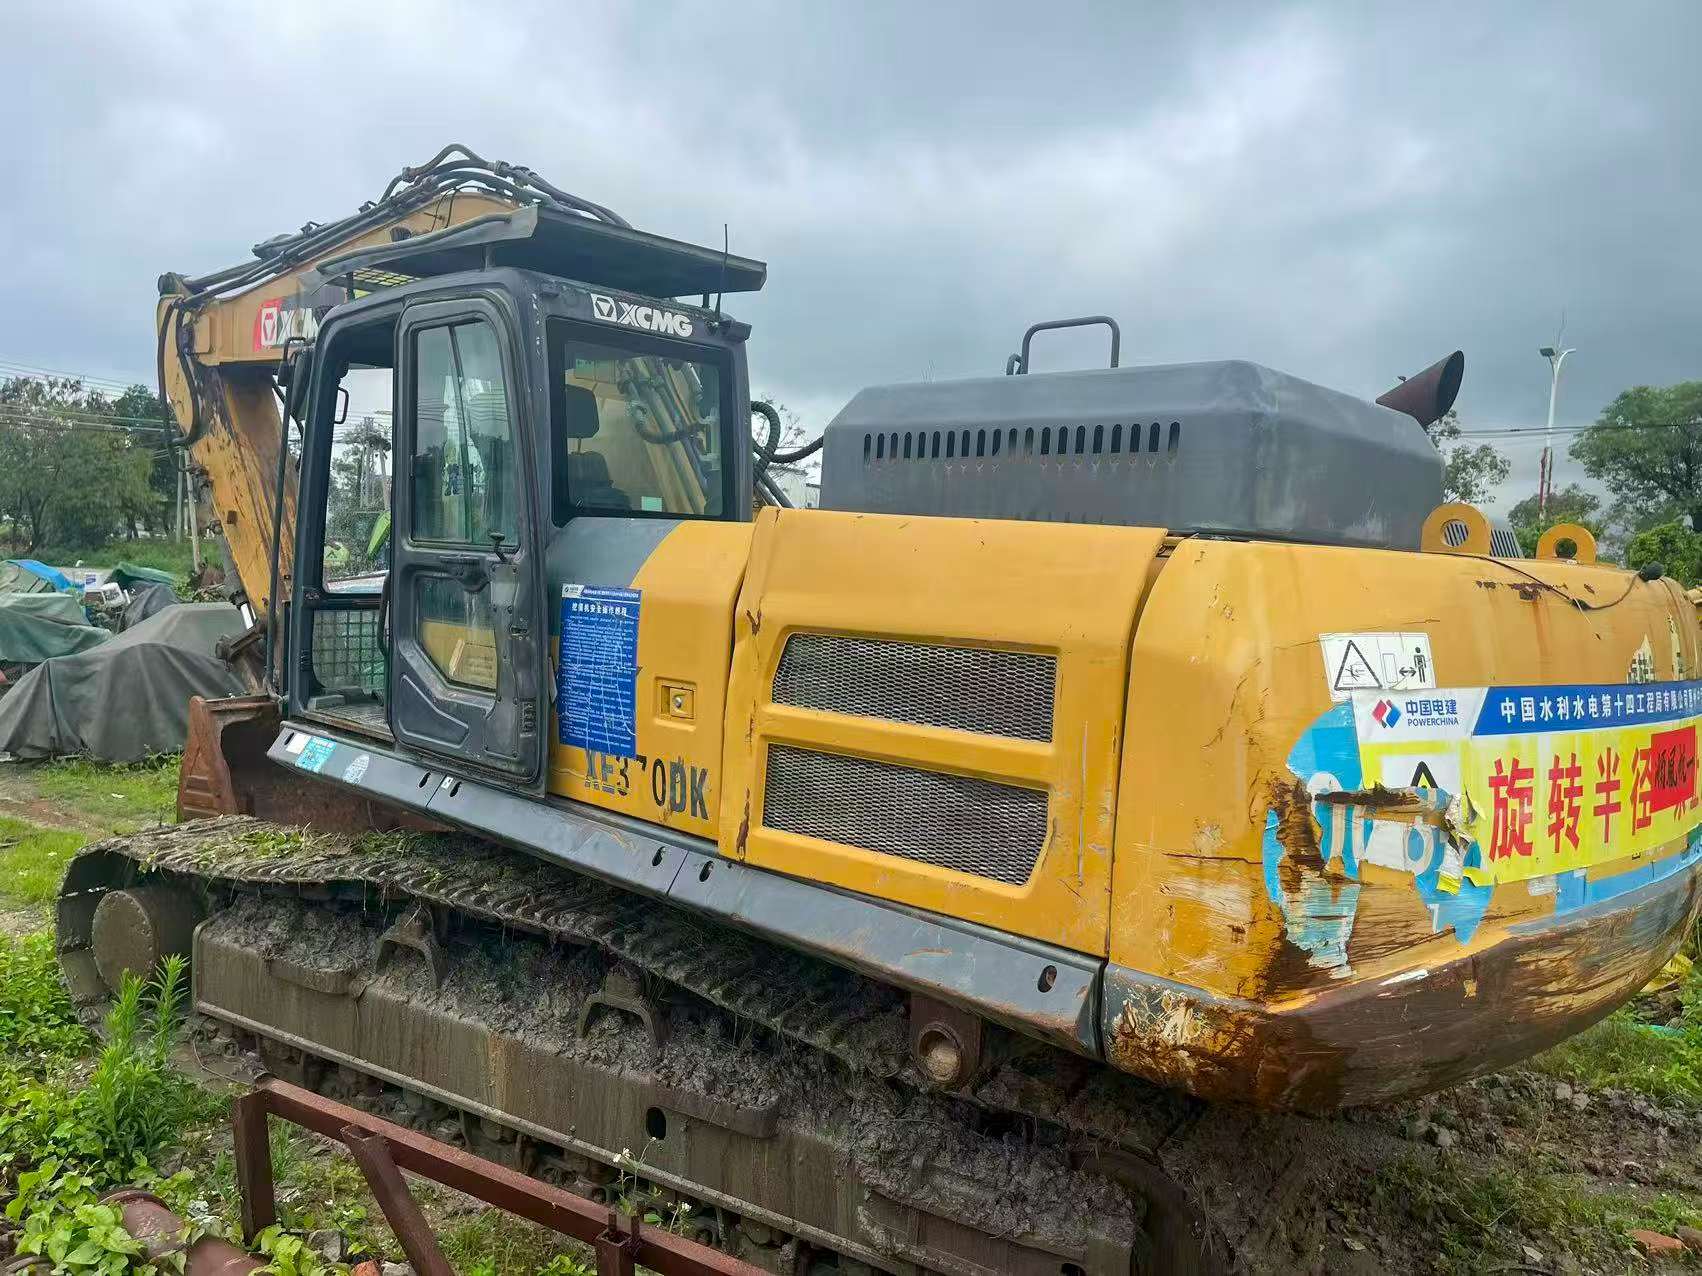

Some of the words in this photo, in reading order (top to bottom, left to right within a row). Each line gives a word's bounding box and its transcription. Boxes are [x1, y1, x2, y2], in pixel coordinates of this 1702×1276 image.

[277, 307, 319, 345] XCM
[617, 301, 693, 337] XCMG
[1405, 699, 1458, 715] 中国电建
[1407, 718, 1459, 726] POWERCHINA
